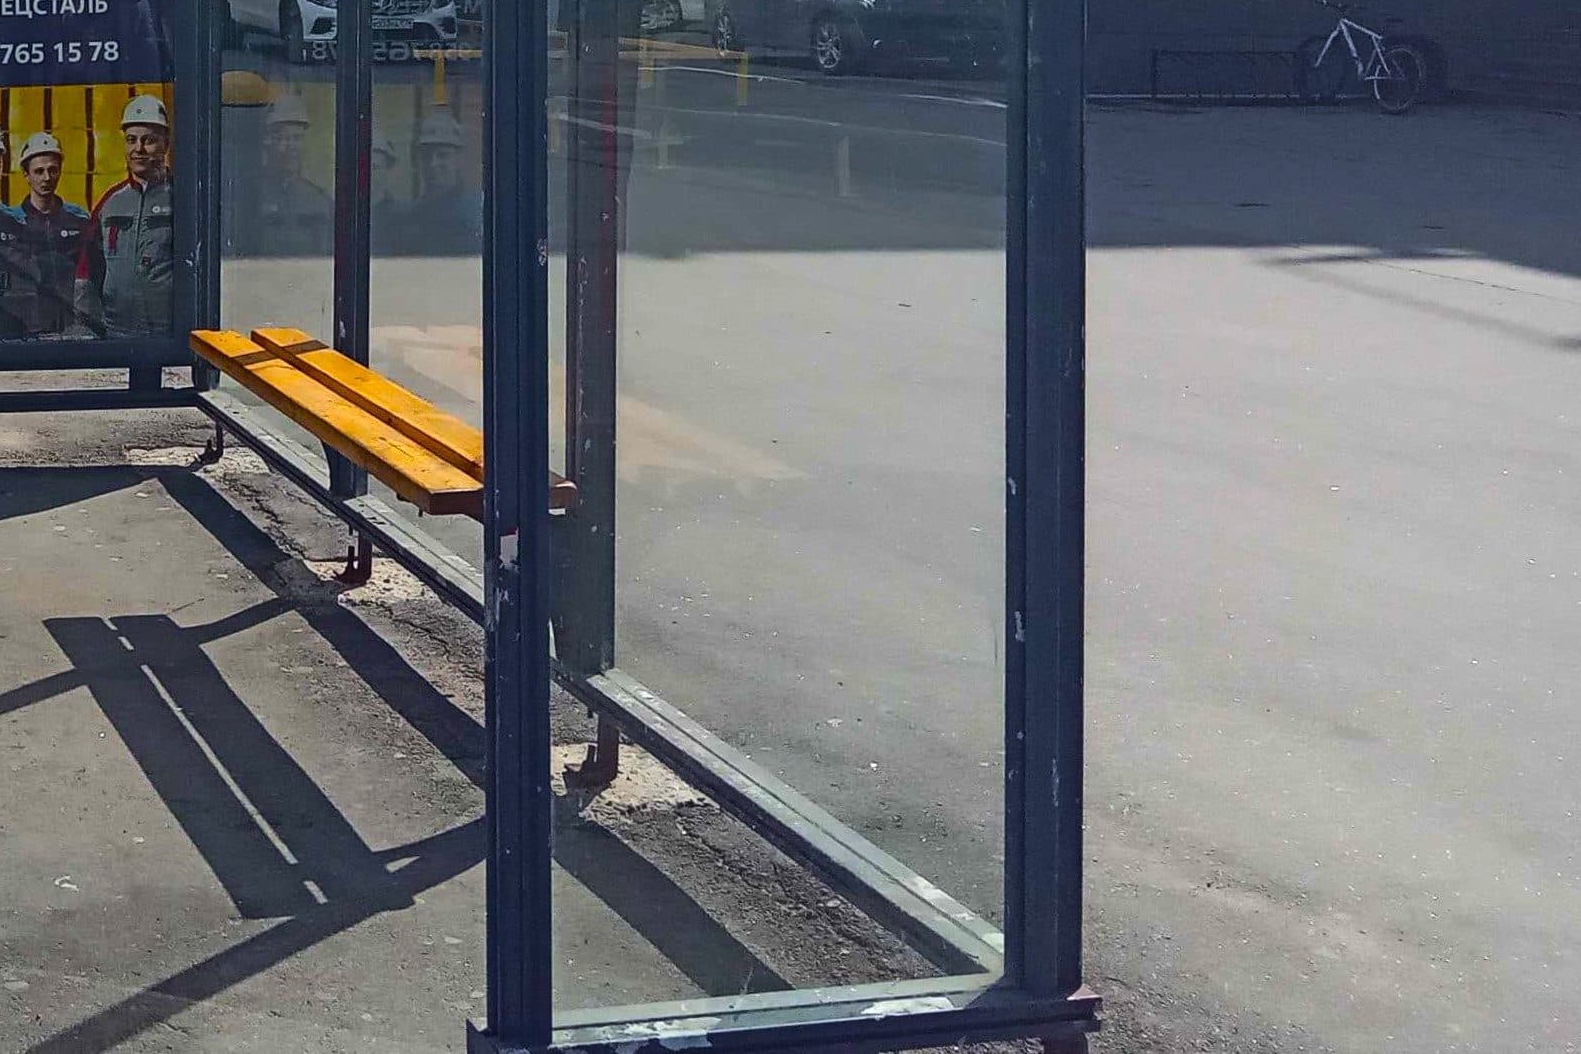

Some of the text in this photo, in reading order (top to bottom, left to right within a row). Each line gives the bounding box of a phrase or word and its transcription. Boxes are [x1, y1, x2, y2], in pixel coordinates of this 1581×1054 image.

[0, 44, 43, 63] 765
[54, 43, 80, 62] 15
[89, 41, 118, 61] 78
